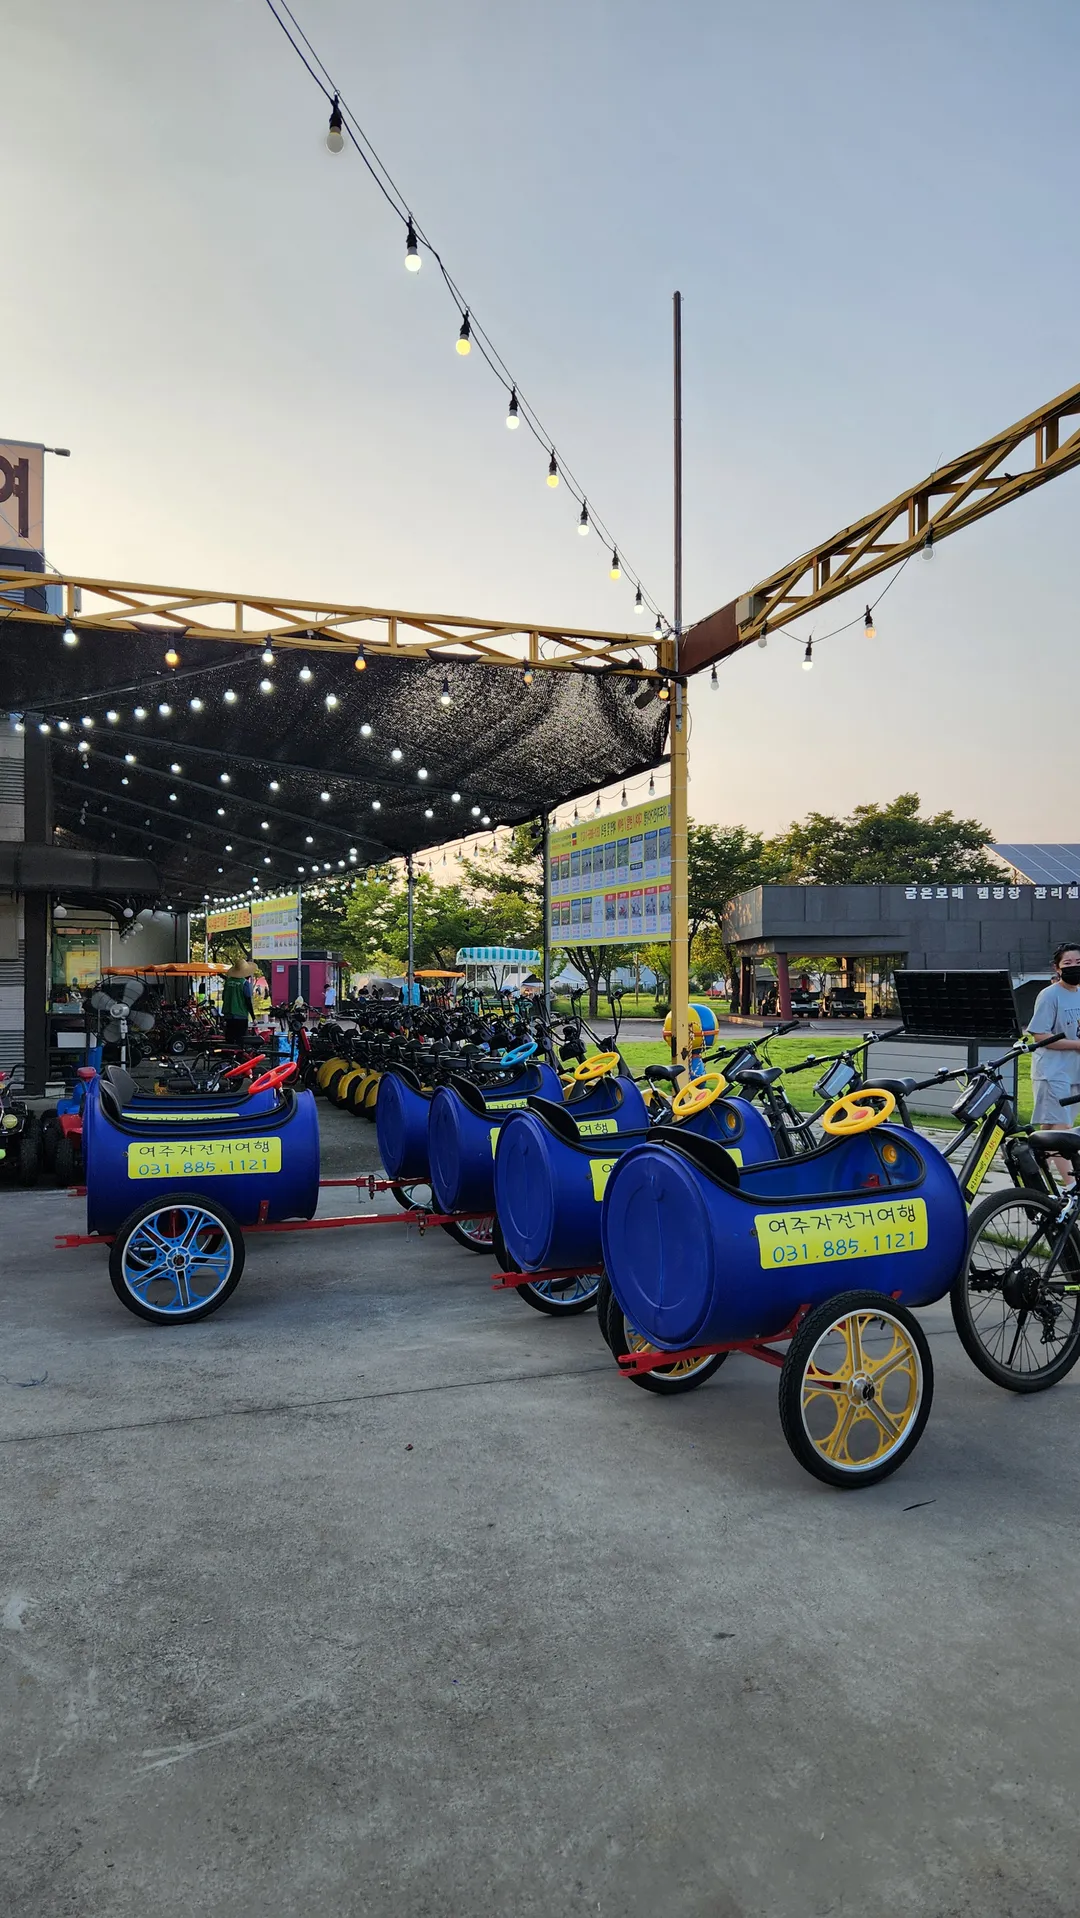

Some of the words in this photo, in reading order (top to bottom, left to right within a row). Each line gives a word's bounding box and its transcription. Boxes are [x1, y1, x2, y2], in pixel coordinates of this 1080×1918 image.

[904, 886, 965, 900] 금은모래
[976, 886, 1021, 900] 캠핑장
[139, 1140, 270, 1158] 여주자전거여행
[138, 1159, 267, 1175] 031.885.1121
[768, 1204, 917, 1236] 여주자전거여행
[772, 1231, 916, 1264] 031.885.1121
